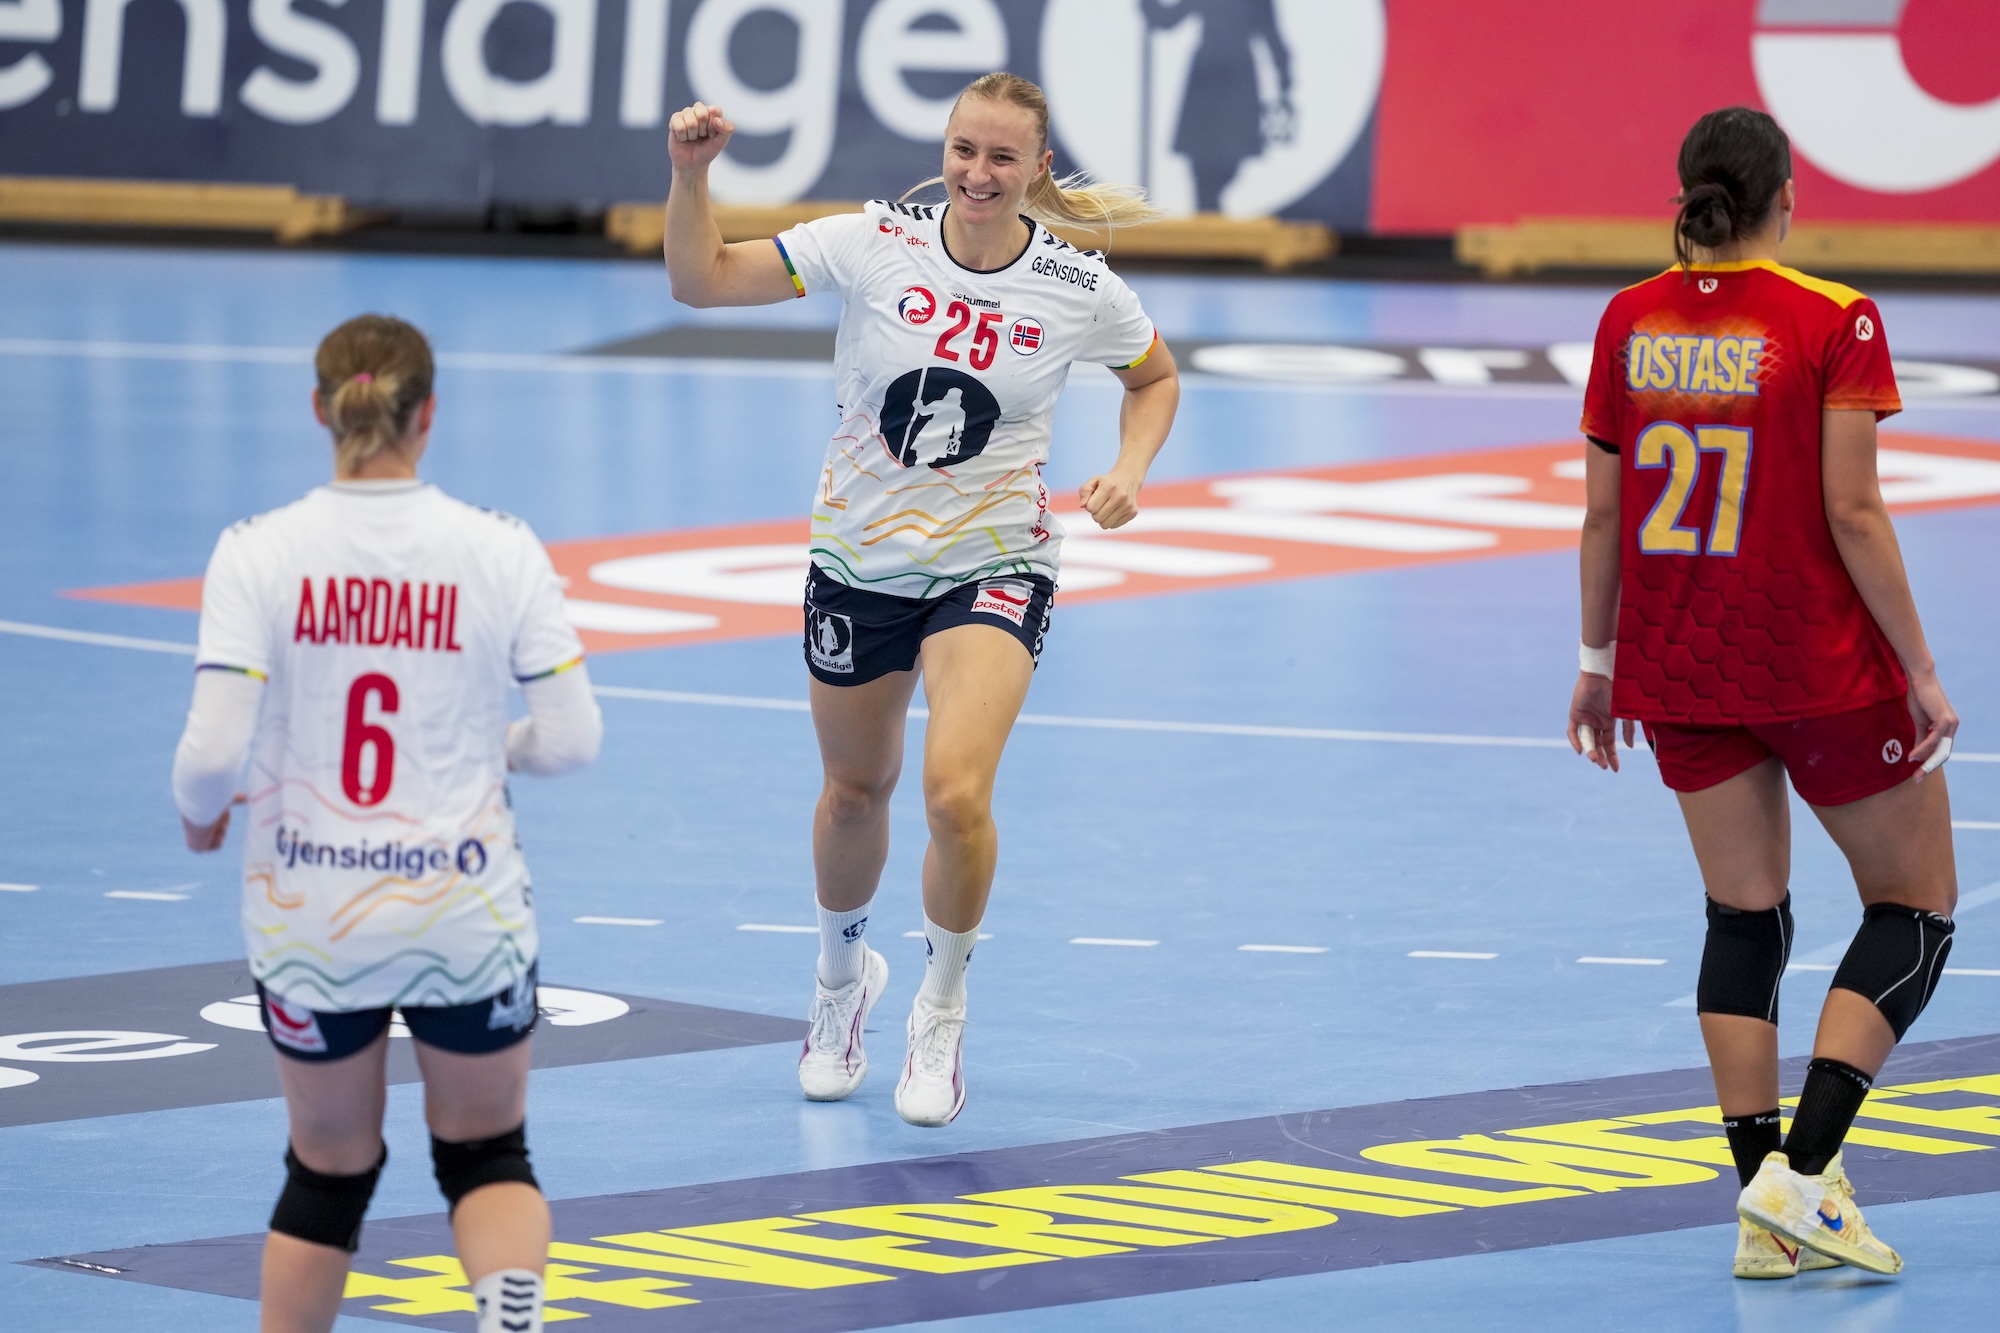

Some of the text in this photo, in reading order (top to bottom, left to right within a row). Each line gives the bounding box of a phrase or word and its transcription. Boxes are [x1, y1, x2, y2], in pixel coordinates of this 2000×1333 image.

[894, 226, 930, 249] psten
[1031, 255, 1099, 292] GJENSIDIGE
[910, 313, 930, 321] NHF
[962, 293, 1001, 309] hummel
[933, 300, 1004, 371] 25
[1627, 332, 1765, 396] OSTASE
[1634, 420, 1753, 556] 27
[294, 575, 463, 653] AARDAHL
[973, 601, 1023, 622] posten
[340, 670, 402, 808] 6
